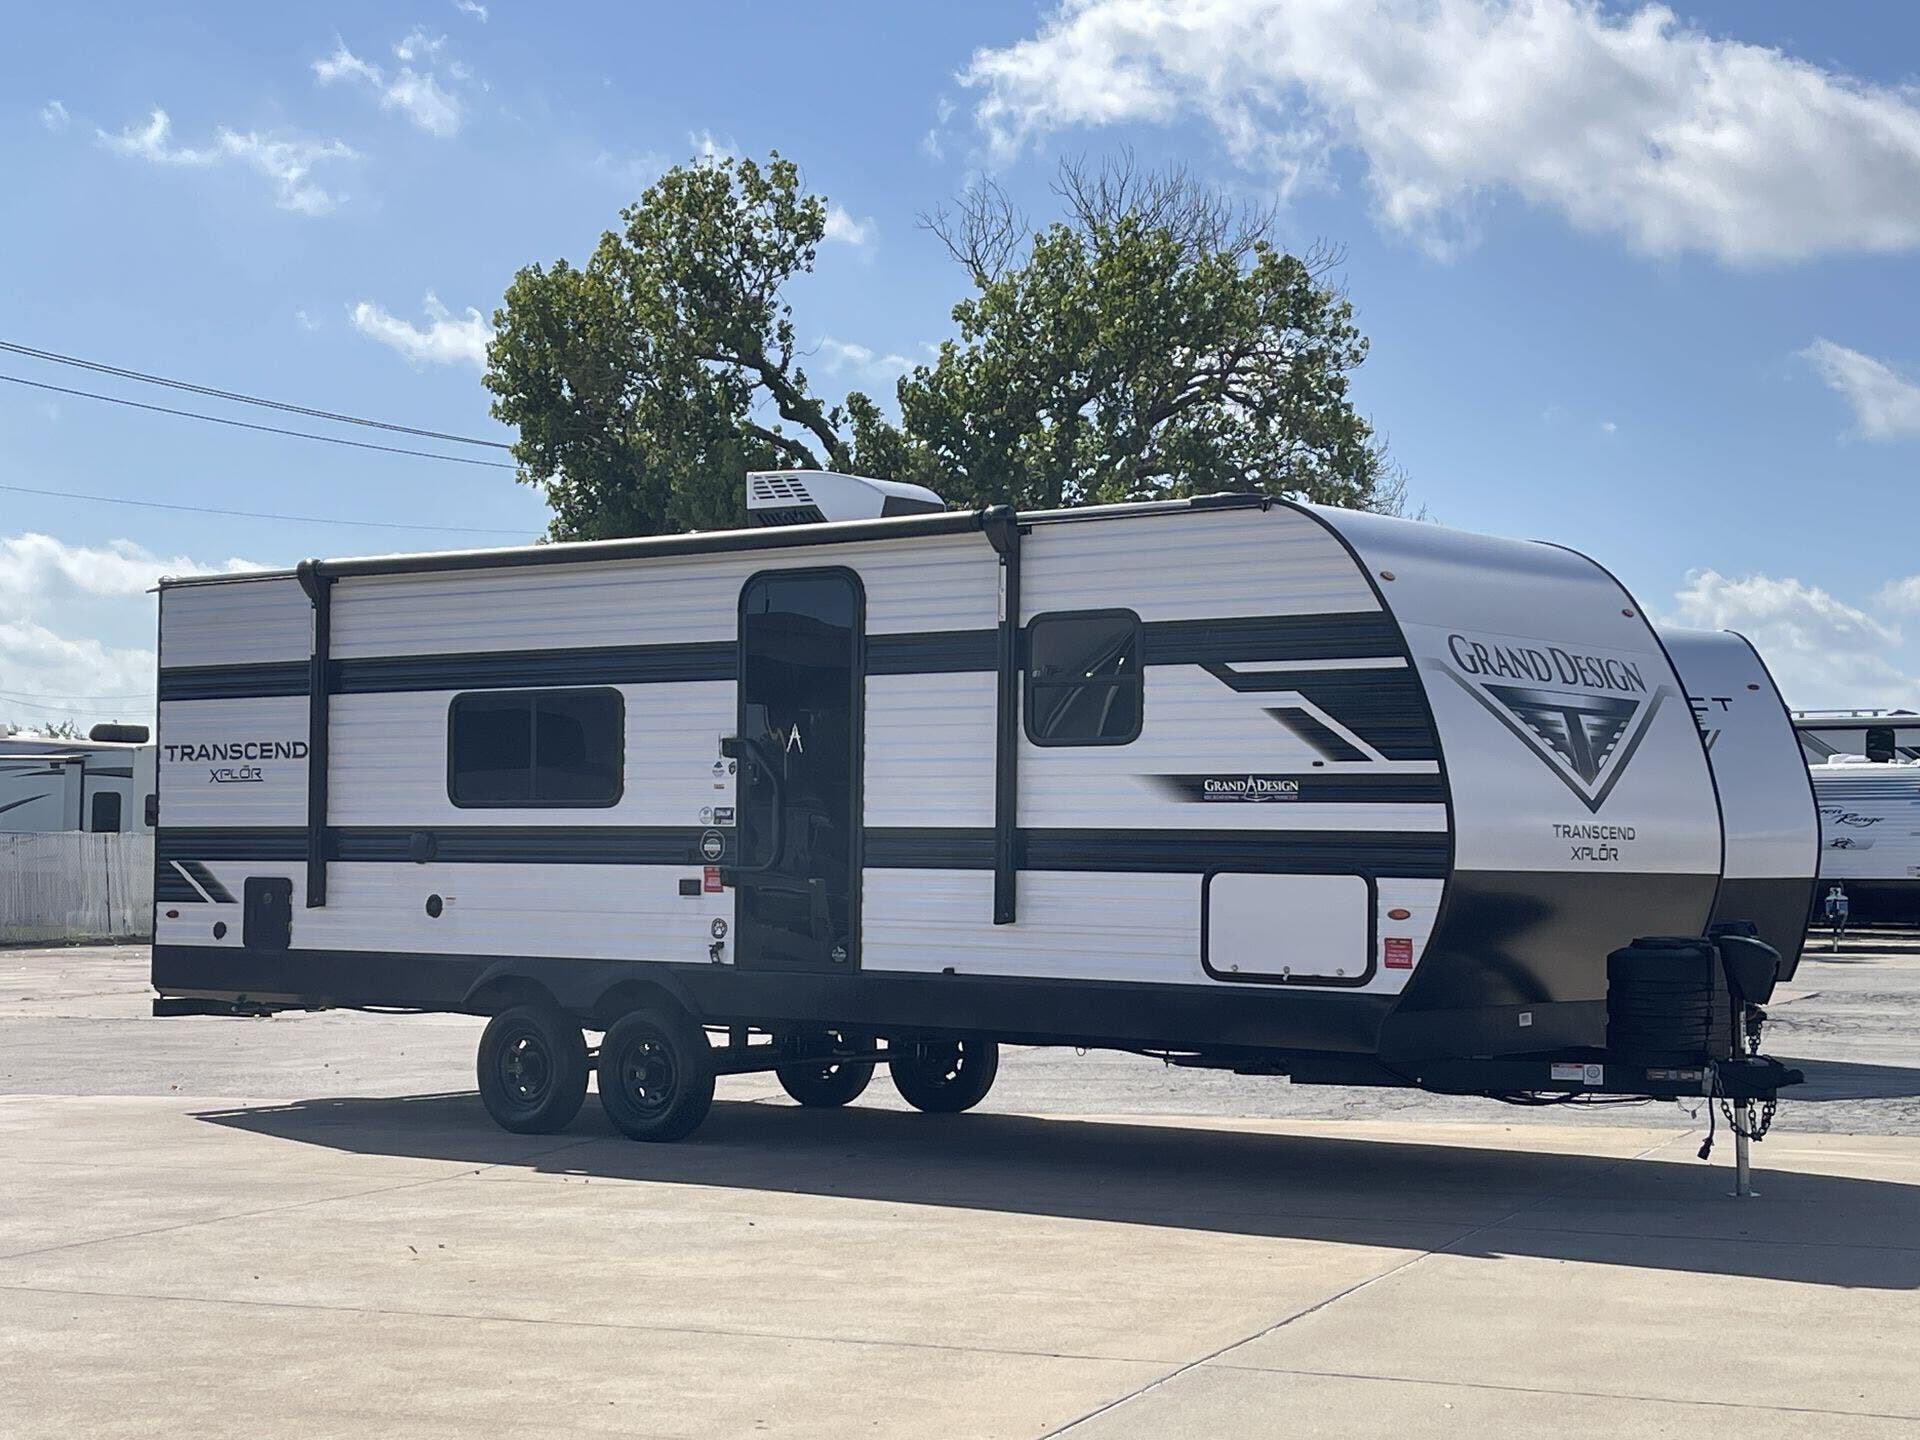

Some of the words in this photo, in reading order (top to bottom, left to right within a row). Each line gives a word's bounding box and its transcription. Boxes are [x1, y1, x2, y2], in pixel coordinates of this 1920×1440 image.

[1448, 634, 1552, 682] GRAND
[1548, 646, 1647, 693] DESIGN
[164, 741, 308, 762] TRANSCEND
[1204, 779, 1246, 792] GRAND
[1256, 779, 1299, 792] DESIGN
[1553, 823, 1636, 841] TRANSCEND
